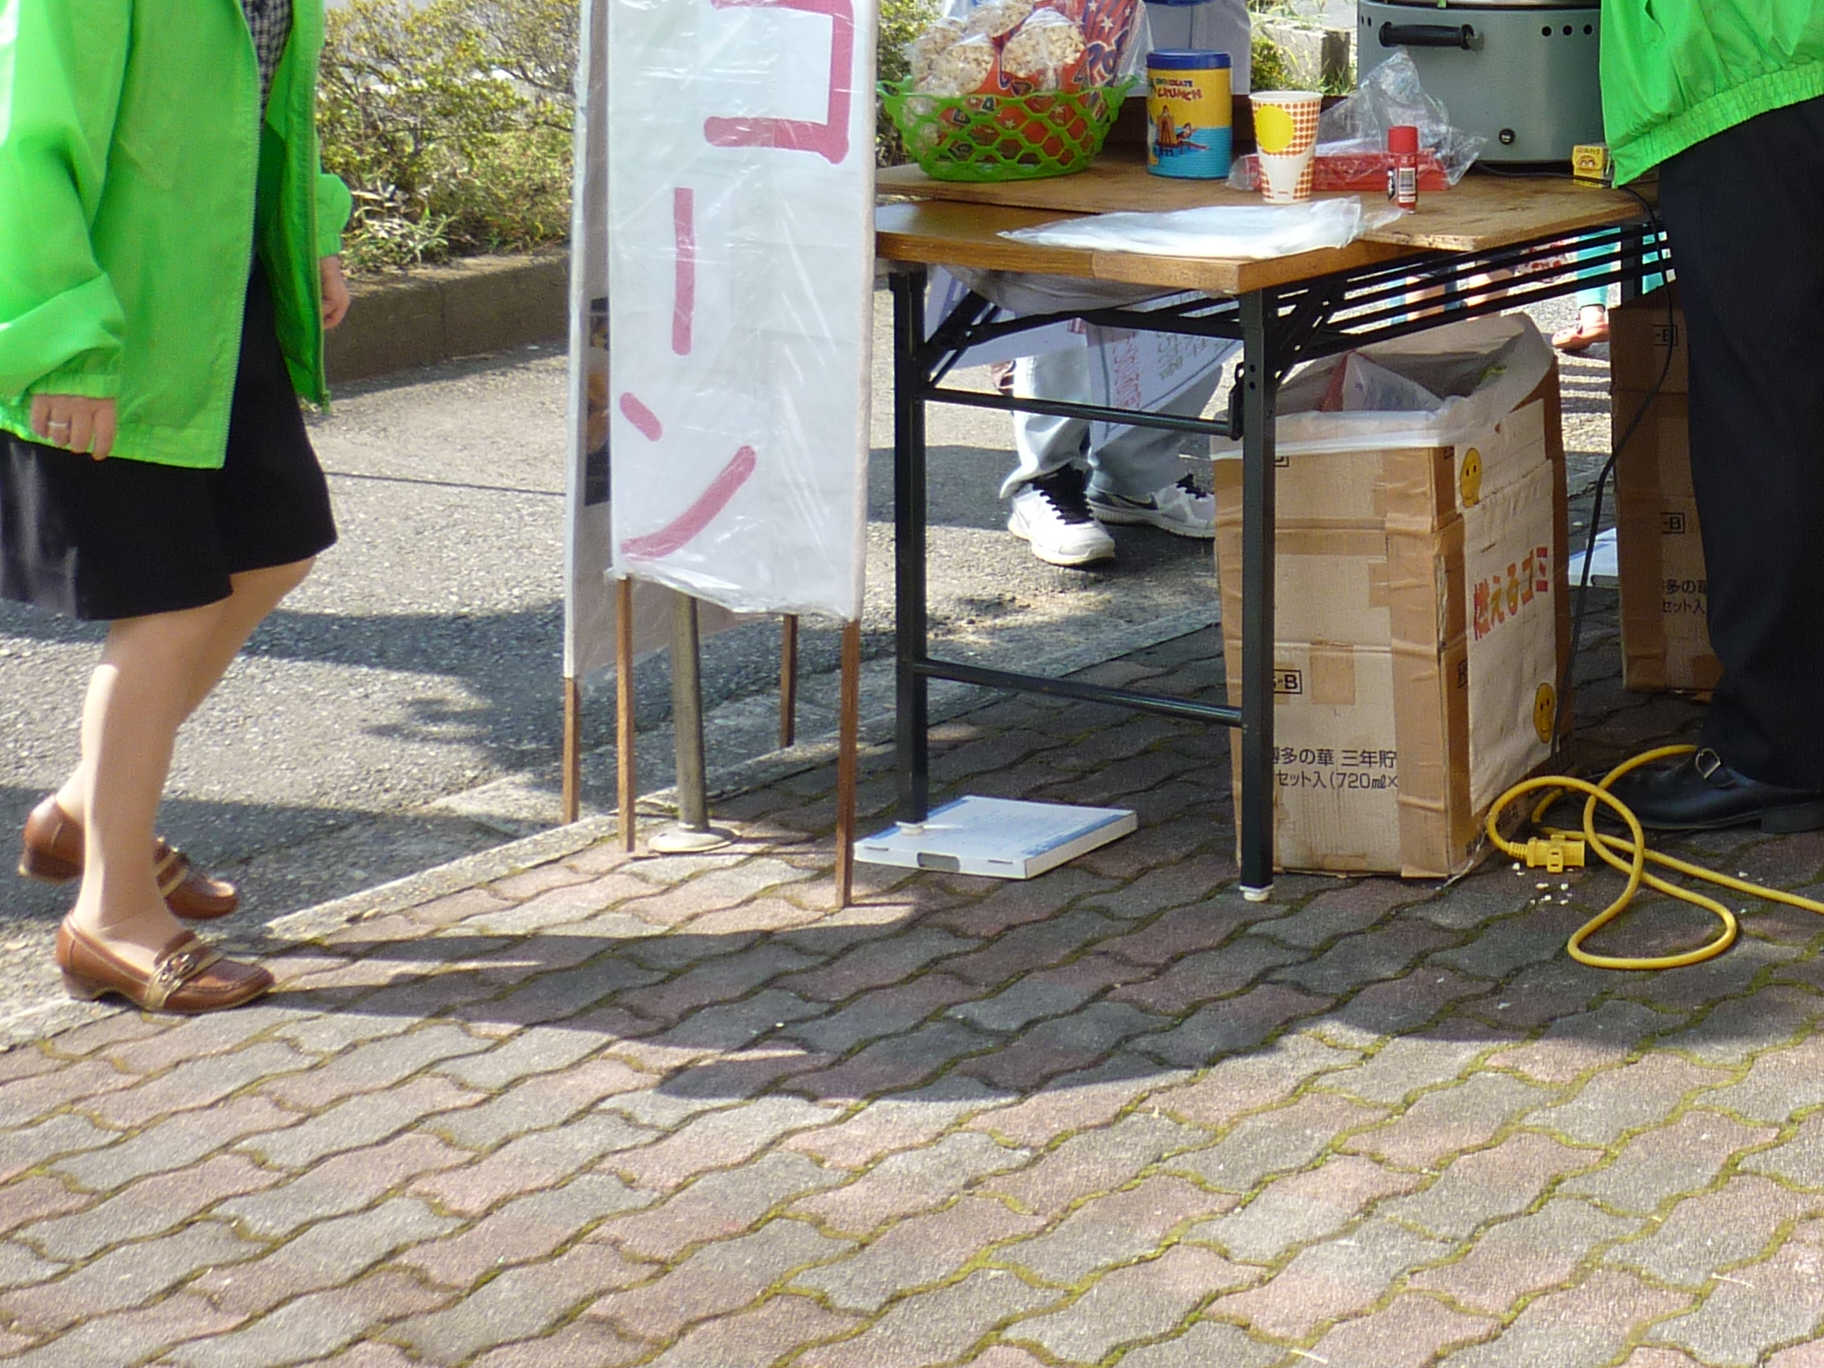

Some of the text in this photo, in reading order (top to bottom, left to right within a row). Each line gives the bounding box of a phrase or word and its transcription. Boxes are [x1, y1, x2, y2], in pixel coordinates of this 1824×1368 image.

[1473, 545, 1550, 642] 燃えるゴミ
